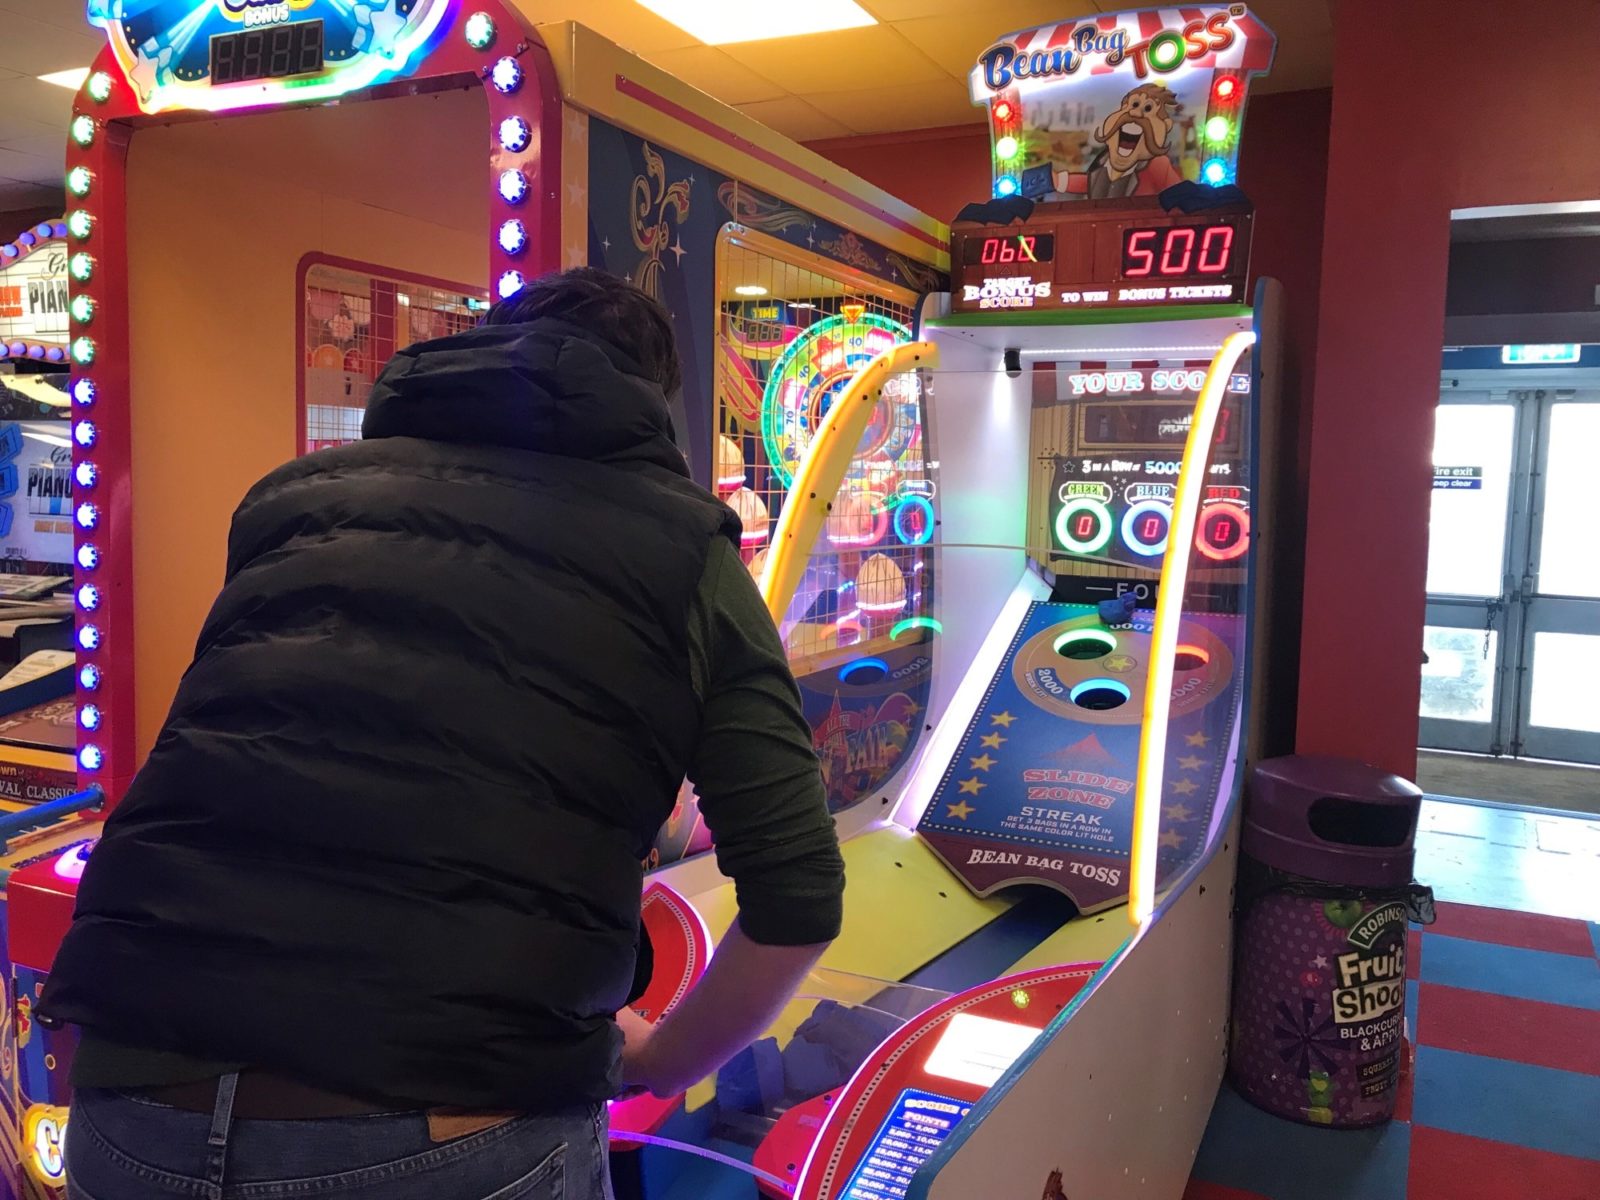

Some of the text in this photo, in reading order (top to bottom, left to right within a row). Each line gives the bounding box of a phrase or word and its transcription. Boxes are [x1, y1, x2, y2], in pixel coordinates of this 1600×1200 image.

[244, 4, 289, 28] BONUS
[979, 43, 1081, 90] Bean
[1073, 24, 1129, 66] Bag
[1126, 12, 1236, 79] TOSS
[1125, 226, 1234, 275] 500
[963, 281, 1051, 301] BONUS
[1061, 285, 1232, 302] TO WIN BONUS TICKETS
[979, 296, 1033, 308] SCORE
[752, 306, 779, 320] TIME
[848, 337, 862, 346] 40
[798, 365, 811, 379] 40
[1069, 370, 1251, 394] YOUR SCOE
[1081, 460, 1091, 474] 3
[1453, 467, 1473, 476] exit
[1067, 484, 1104, 496] GREEN
[1136, 486, 1170, 497] BLUE
[1451, 479, 1472, 487] clear
[1208, 488, 1241, 499] RED
[1077, 516, 1093, 536] 0
[1144, 518, 1159, 538] 0
[1214, 521, 1231, 542] 0
[1038, 668, 1064, 694] 2000
[1170, 677, 1202, 700] 000
[1023, 768, 1134, 795] SLIDE
[1028, 787, 1116, 810] ZONE
[1006, 815, 1023, 823] GET
[1034, 819, 1058, 828] BAGS
[1079, 824, 1099, 833] ROW
[1020, 806, 1103, 826] STREAK
[1000, 821, 1115, 843] THE SAME COLOR LIT HOLE
[967, 848, 1122, 887] BEAN BAG TOSS
[1338, 943, 1403, 988] Fruit
[1360, 1037, 1371, 1051] &
[903, 1111, 950, 1128] POINTS
